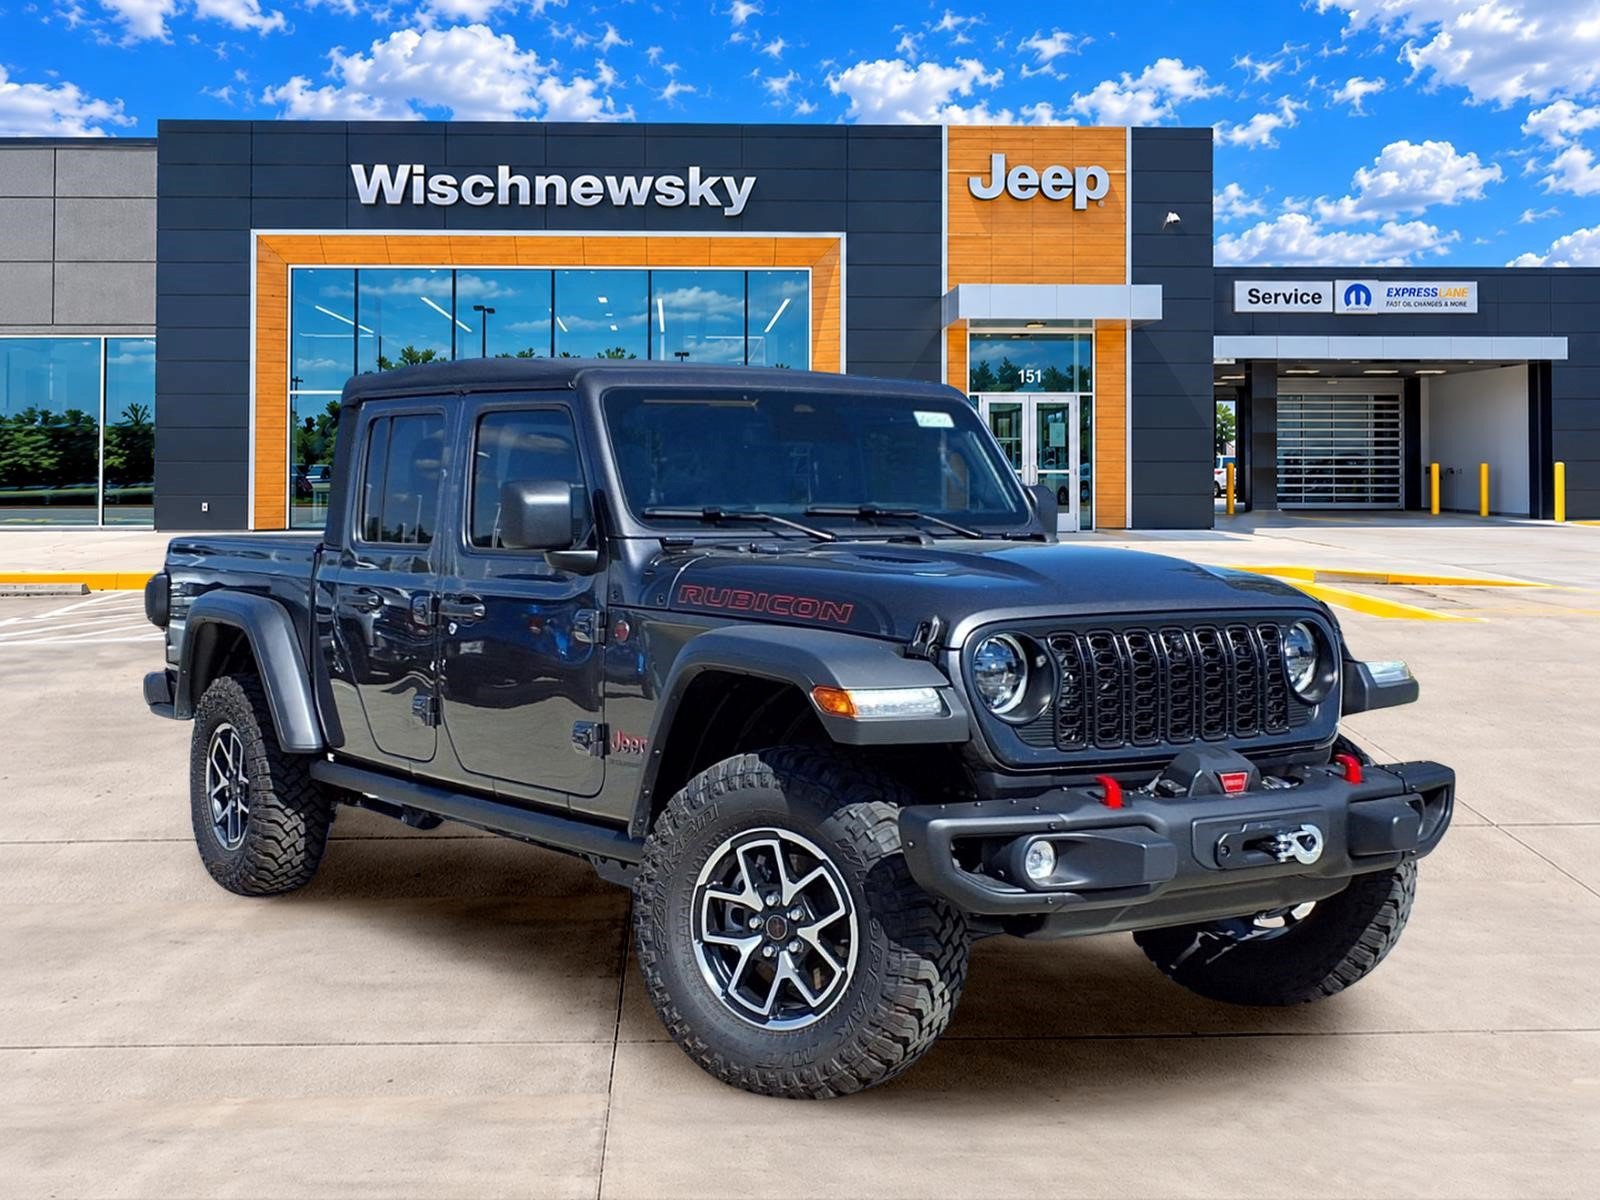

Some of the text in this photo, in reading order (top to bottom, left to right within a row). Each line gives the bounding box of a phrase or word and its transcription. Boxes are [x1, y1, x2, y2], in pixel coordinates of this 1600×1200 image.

[350, 163, 757, 216] Wischnewsky
[968, 153, 1110, 210] Jeep
[1247, 288, 1322, 305] Service
[1018, 369, 1041, 383] 151
[678, 584, 854, 624] RUBICON
